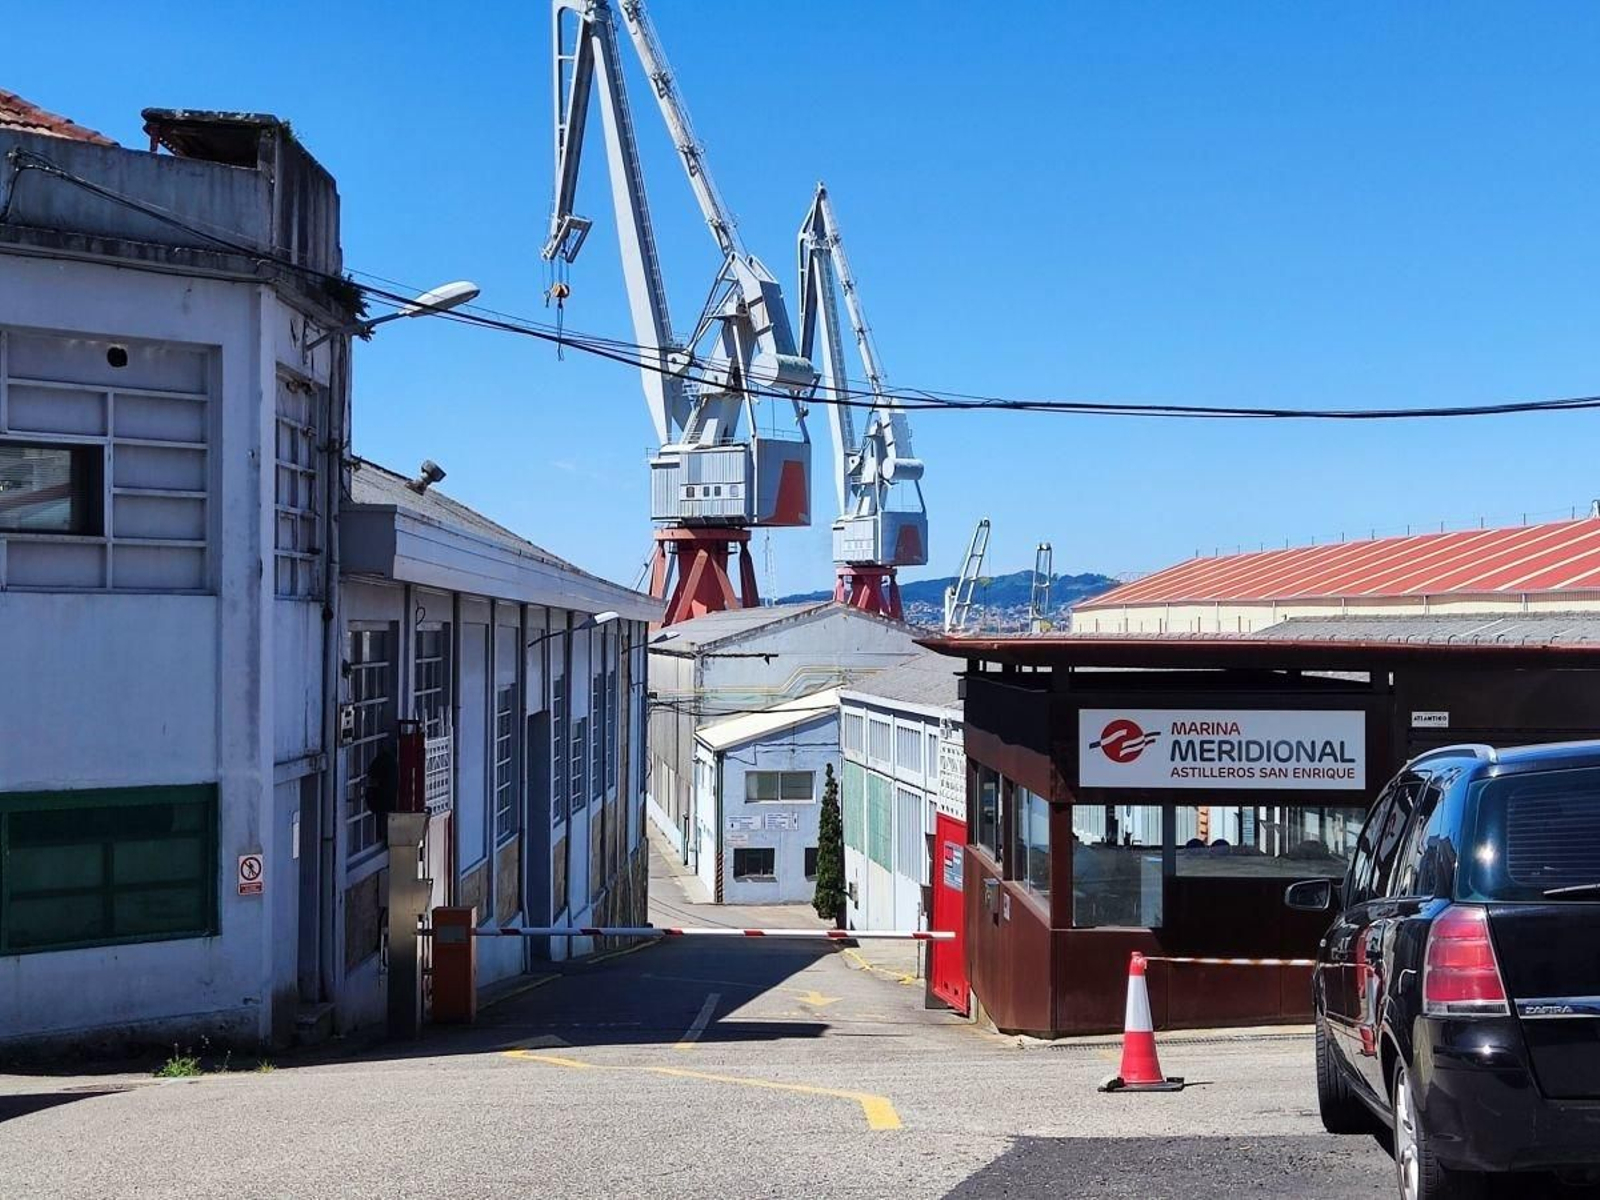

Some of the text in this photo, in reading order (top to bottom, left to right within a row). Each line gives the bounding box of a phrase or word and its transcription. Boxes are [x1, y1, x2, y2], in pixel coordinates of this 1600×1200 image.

[1171, 721, 1241, 736] MARINA
[1170, 739, 1356, 763] MERIDIONAL
[1170, 766, 1355, 780] ASTILLEROS SAN ENRIQUE
